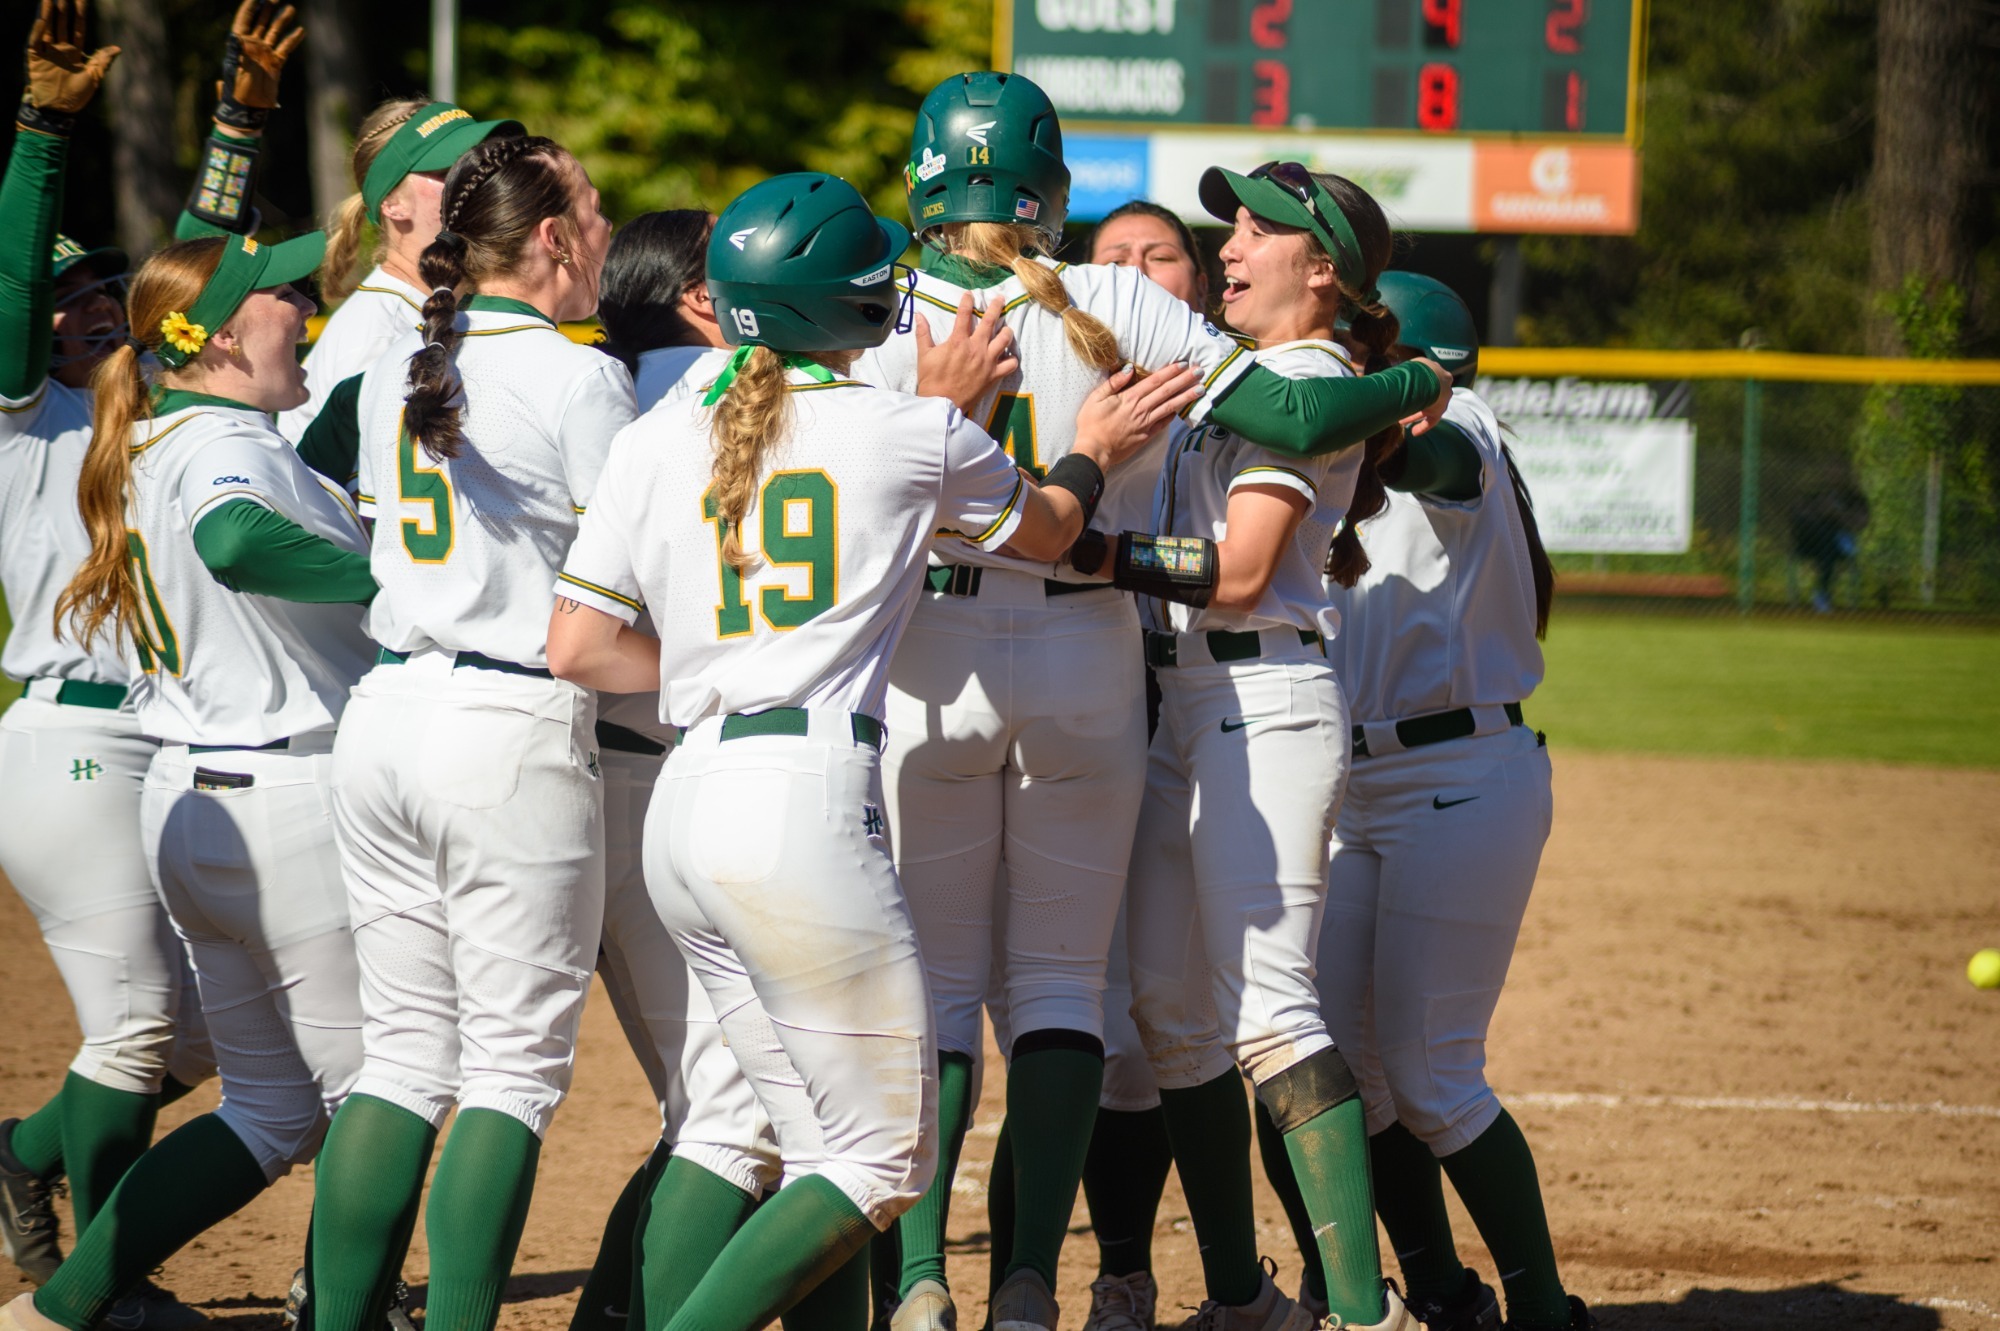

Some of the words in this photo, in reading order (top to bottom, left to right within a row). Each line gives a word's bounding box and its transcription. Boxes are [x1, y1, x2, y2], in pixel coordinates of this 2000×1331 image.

[1250, 0, 1292, 48] 2
[1545, 0, 1585, 54] 2
[1251, 60, 1291, 132] 3
[1417, 62, 1458, 133] 8
[1565, 70, 1581, 132] 1
[970, 146, 989, 165] 14
[922, 201, 945, 219] JACKS
[862, 269, 888, 284] EASTON
[730, 308, 760, 337] 19
[396, 405, 455, 565] 5
[700, 467, 840, 641] 19
